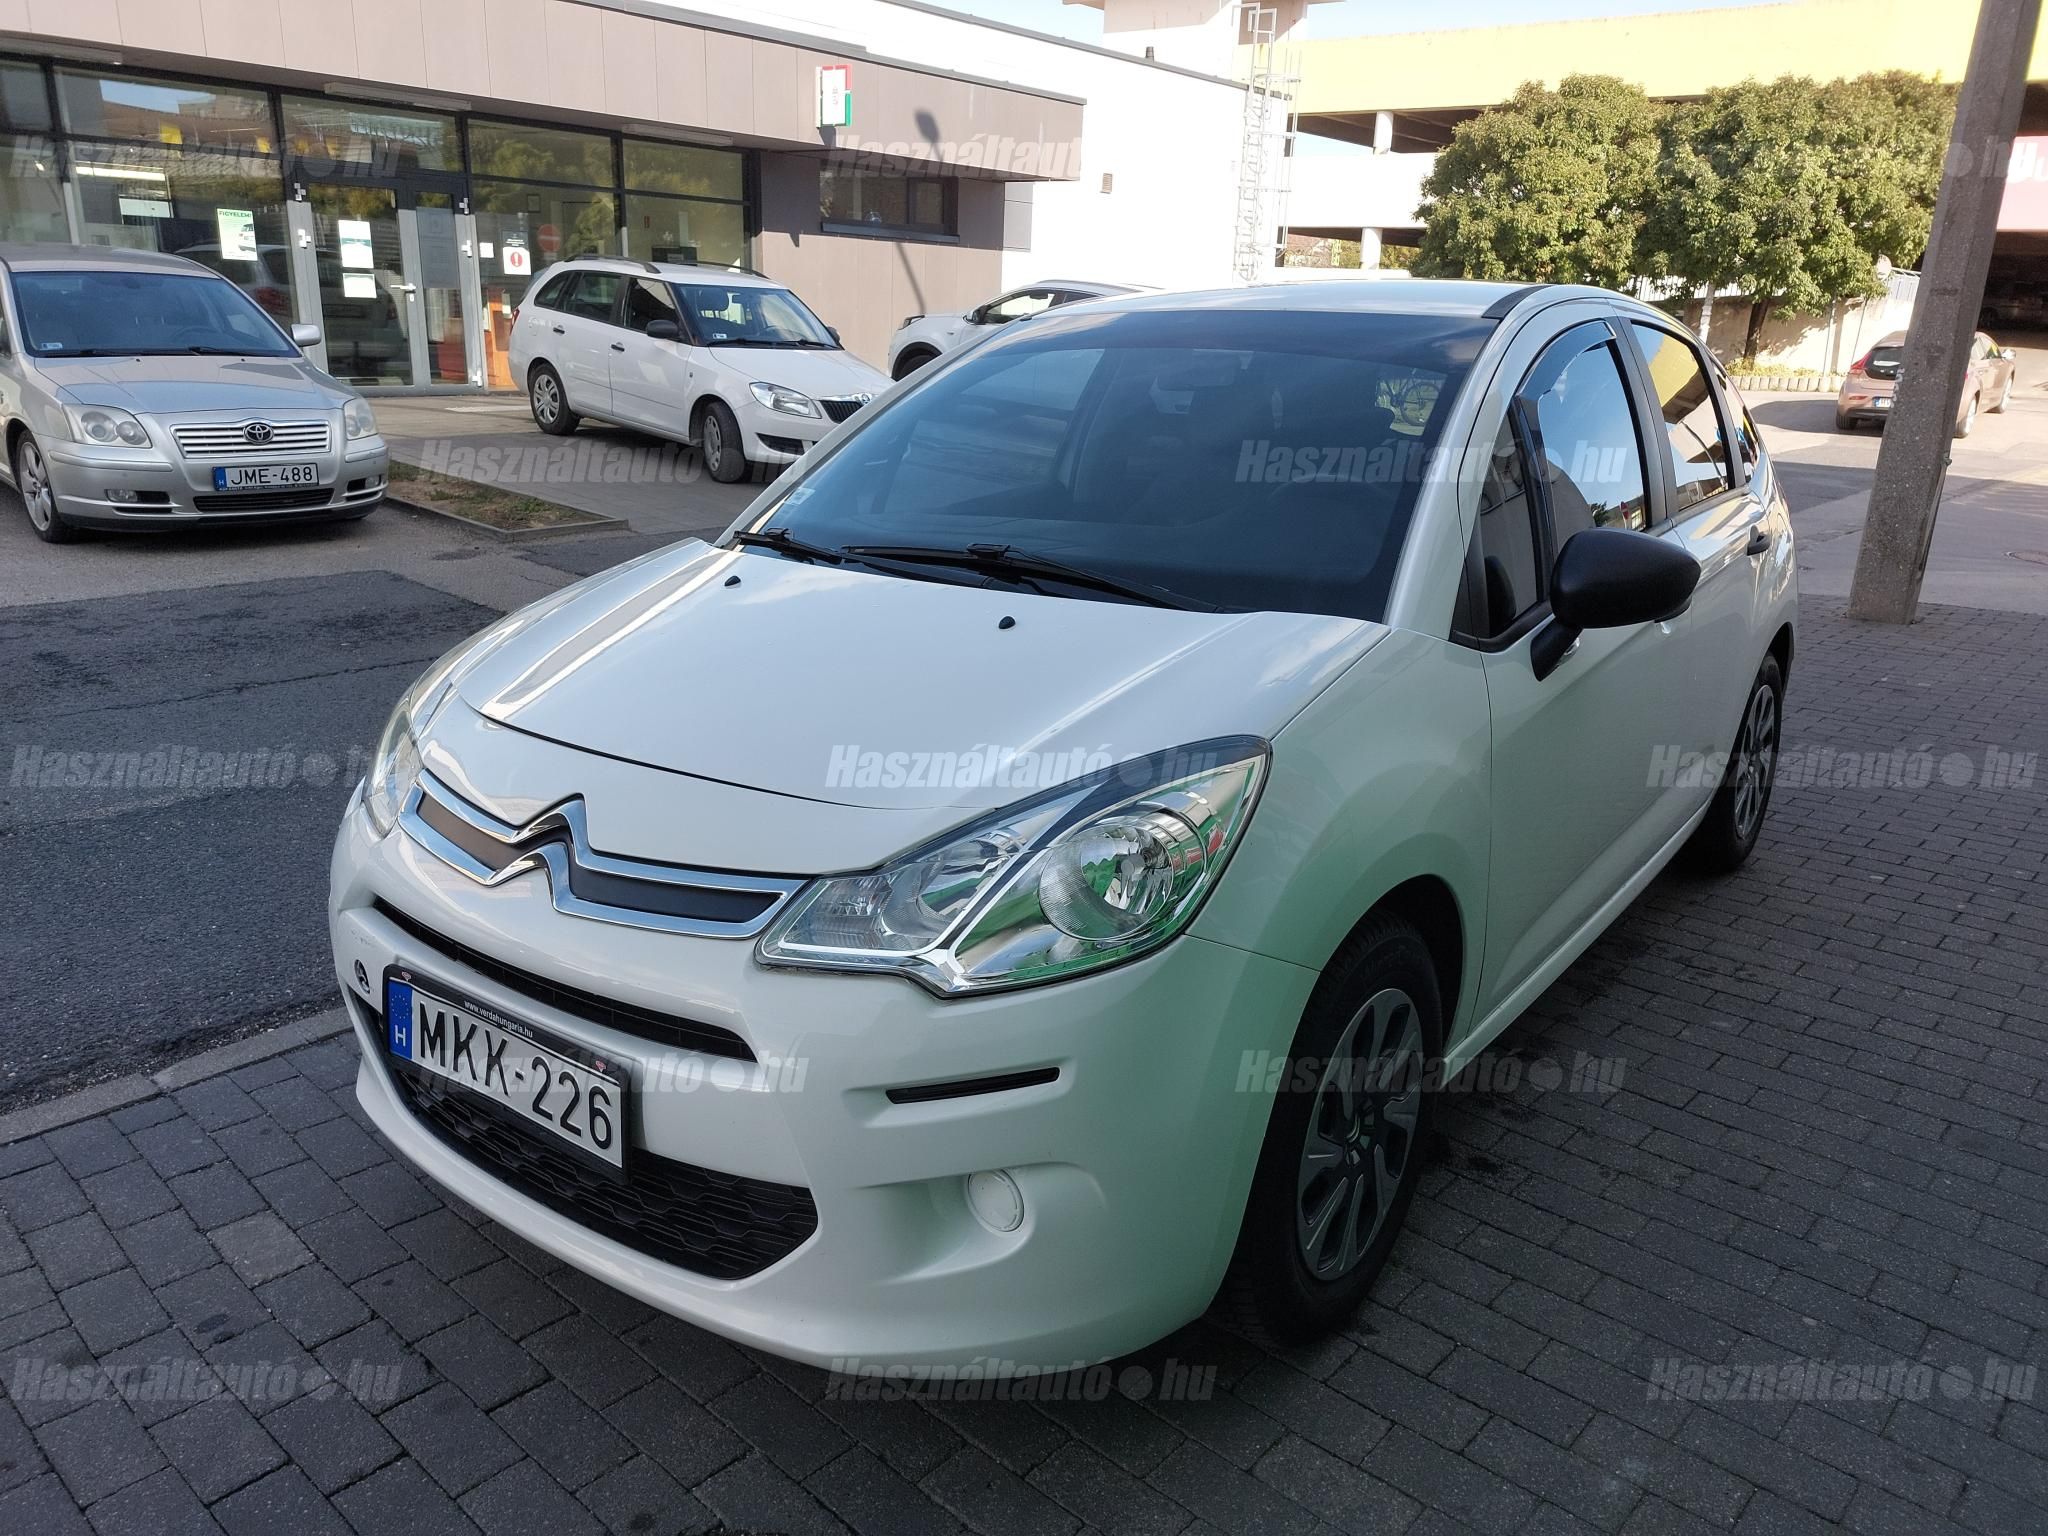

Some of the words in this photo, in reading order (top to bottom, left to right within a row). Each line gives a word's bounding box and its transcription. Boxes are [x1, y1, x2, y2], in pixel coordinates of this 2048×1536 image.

[231, 466, 313, 485] JME-488
[464, 1000, 533, 1038] www.verdahungaria.hu
[394, 1025, 406, 1047] H
[419, 1001, 613, 1150] MKK-226
